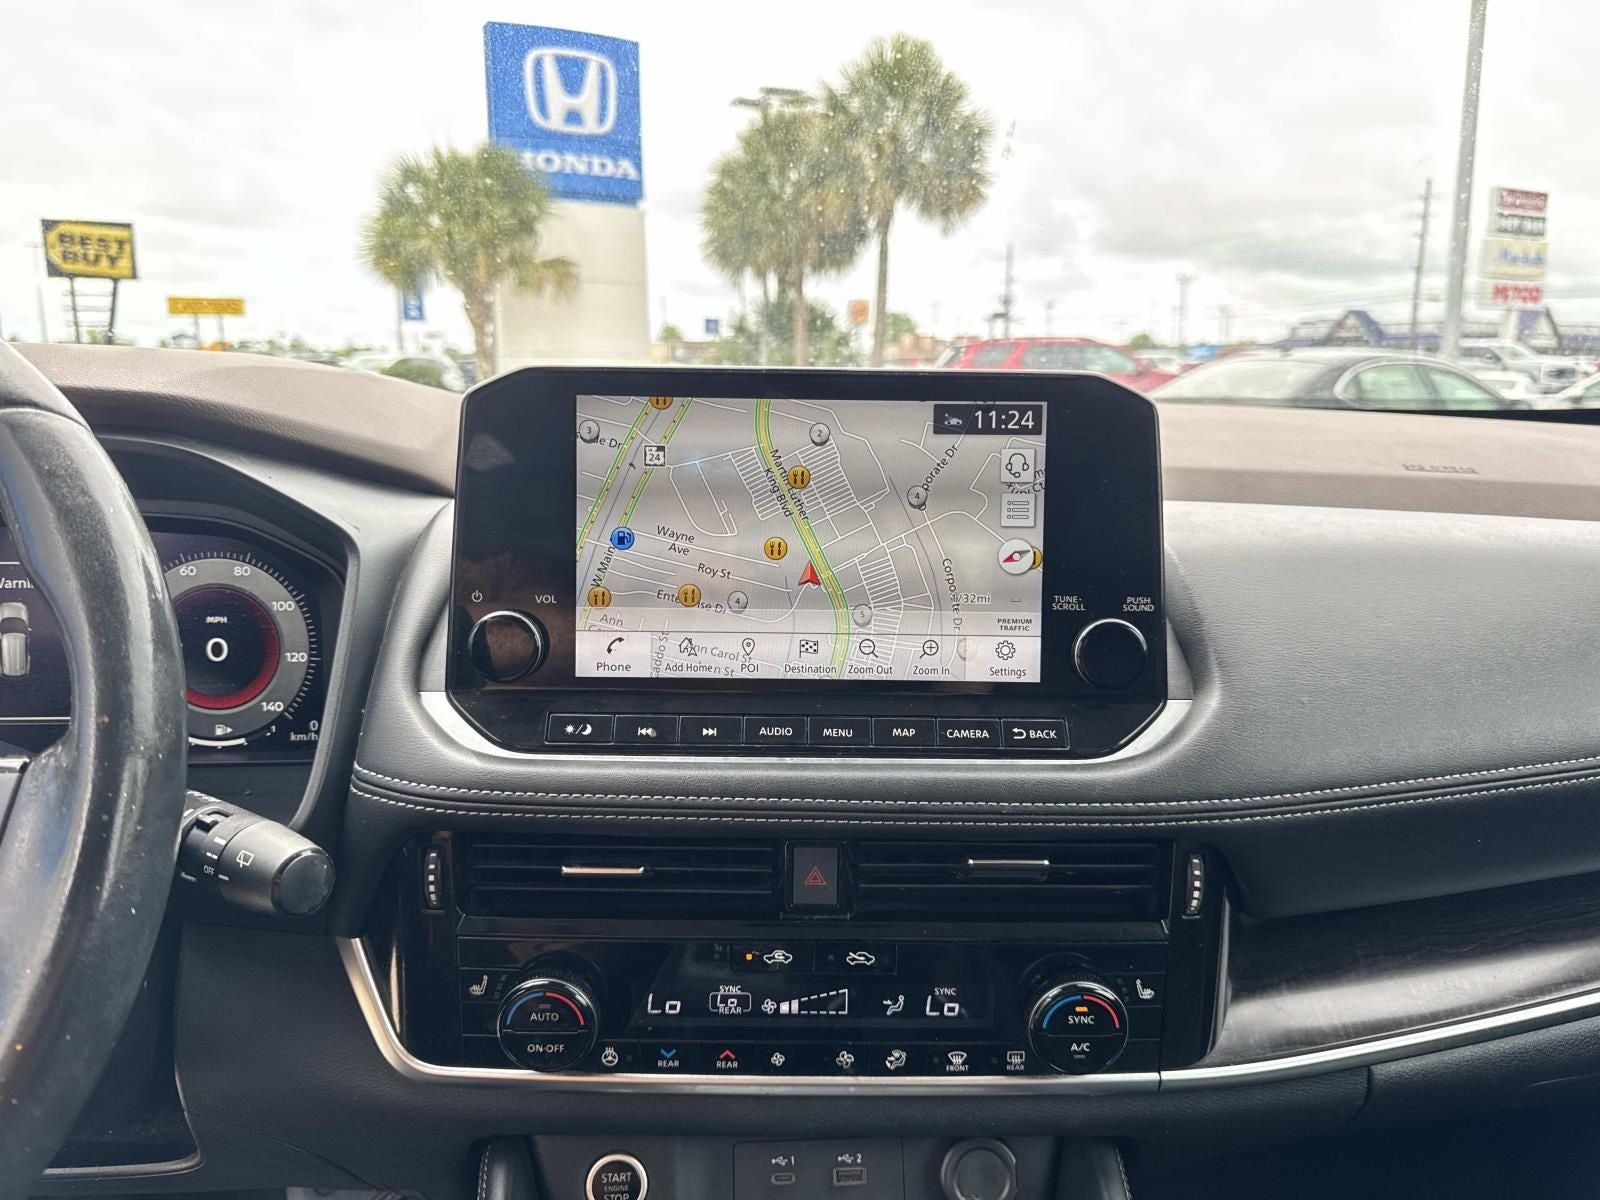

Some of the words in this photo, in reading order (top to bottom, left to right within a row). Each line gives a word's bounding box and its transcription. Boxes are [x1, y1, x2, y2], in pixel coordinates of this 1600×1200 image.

[59, 233, 128, 250] BEST
[62, 250, 119, 268] BUY
[974, 410, 1035, 429] 11:24
[586, 426, 592, 434] 3
[817, 429, 822, 437] 2
[945, 444, 958, 458] Dr
[648, 453, 661, 462] 24
[764, 468, 780, 493] King
[776, 494, 794, 517] Blvd
[657, 525, 695, 543] Wayne
[668, 543, 690, 556] Ave
[180, 566, 197, 576] 60
[233, 566, 251, 576] 80
[591, 574, 603, 588] W
[597, 546, 615, 574] Main
[697, 562, 718, 578] Roy
[718, 569, 731, 579] St
[0, 577, 34, 589] arni
[534, 594, 557, 604] VOL
[656, 589, 712, 609] Enteise
[942, 558, 960, 614] Corpote
[953, 617, 963, 631] Dr
[951, 593, 990, 604] 1/32mi
[1126, 596, 1151, 604] PUSH
[272, 601, 295, 611] 100
[1051, 603, 1086, 611] SCROLL
[1122, 604, 1154, 612] SOUND
[206, 616, 228, 624] MPH
[600, 614, 623, 627] Ann
[206, 638, 228, 662] 0
[711, 646, 740, 662] Carol
[285, 652, 308, 662] 120
[596, 661, 632, 672] Phone
[665, 663, 683, 673] Add
[686, 663, 713, 673] Home
[741, 663, 759, 673] POI
[784, 664, 837, 674] Destination
[848, 665, 874, 675] Zoom
[876, 665, 893, 675] Out
[913, 666, 939, 675] Zoom
[942, 666, 950, 675] In
[989, 666, 1027, 678] Settings
[261, 701, 284, 711] 140
[310, 720, 318, 731] 0
[290, 731, 318, 741] km/h
[759, 727, 793, 737] AUDIO
[823, 728, 853, 737] MENU
[892, 728, 916, 737] MAP
[946, 729, 990, 739] CAMERA
[1029, 730, 1057, 739] BACK
[203, 865, 215, 875] OFF
[719, 985, 742, 993] SYNC
[934, 986, 957, 996] SYNC
[719, 1006, 742, 1014] REAR
[530, 1012, 559, 1022] AUTO
[1067, 1015, 1095, 1024] SYNC
[1070, 1042, 1090, 1052] A/C
[657, 1059, 680, 1067] REAR
[716, 1061, 738, 1069] REAR
[946, 1064, 969, 1072] FRONT
[1006, 1063, 1025, 1071] REAR
[791, 1155, 795, 1166] 1
[856, 1153, 862, 1163] 2
[601, 1172, 632, 1183] START
